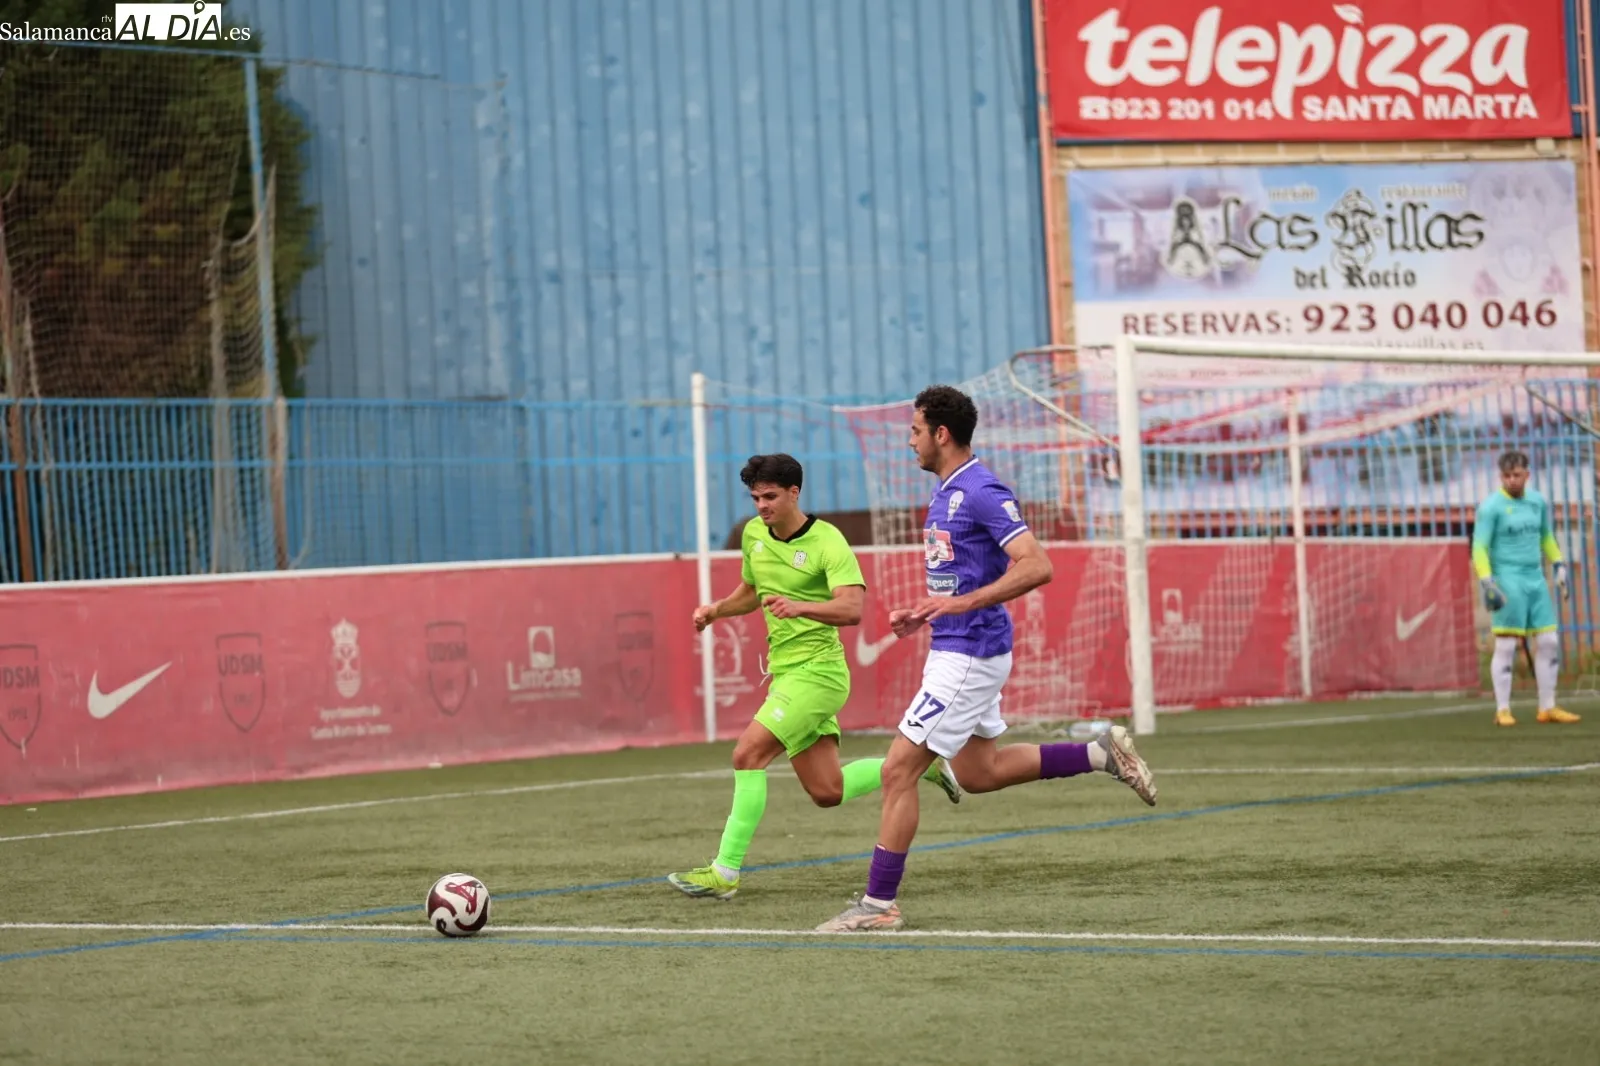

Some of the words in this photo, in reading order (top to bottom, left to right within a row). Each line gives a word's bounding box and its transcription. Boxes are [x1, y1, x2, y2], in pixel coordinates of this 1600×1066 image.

[1077, 3, 1530, 119] telepizza
[1110, 97, 1162, 120] 923
[1167, 97, 1216, 120] 201
[1223, 97, 1274, 120] 014
[1302, 95, 1415, 121] SANTA
[1422, 93, 1539, 120] MARTA
[1293, 265, 1328, 289] del
[1122, 311, 1292, 336] RESERVAS:
[1303, 303, 1377, 333] 923
[1392, 301, 1468, 332] 040
[1482, 299, 1558, 329] 046
[0, 665, 40, 689] DSM
[913, 691, 946, 721] 17
